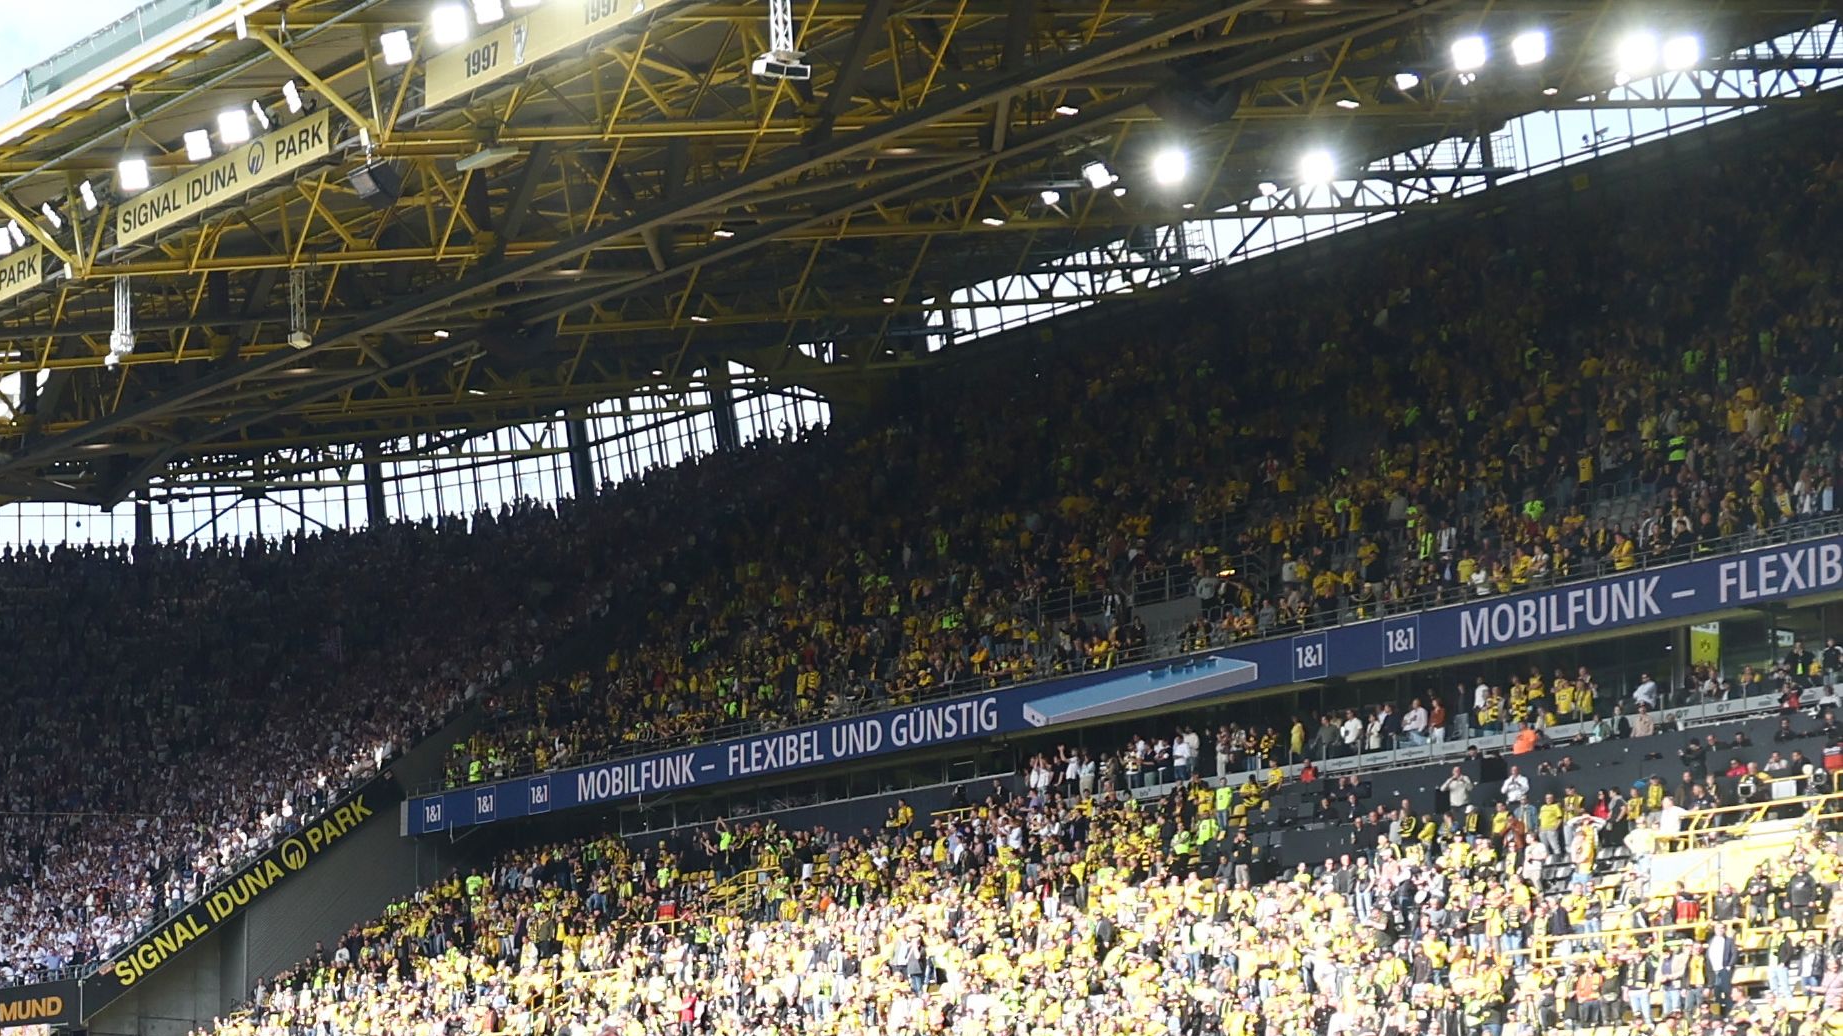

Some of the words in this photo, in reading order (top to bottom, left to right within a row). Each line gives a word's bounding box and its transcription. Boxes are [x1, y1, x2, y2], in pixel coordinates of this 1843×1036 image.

[464, 41, 499, 78] 1997
[122, 190, 181, 234] SIGNAL
[186, 162, 238, 206] IDUNA
[275, 120, 324, 164] PARK
[1460, 575, 1662, 649] MOBILFUNK
[1719, 543, 1843, 603] FLEXIB
[1295, 643, 1324, 669] 1&1
[1386, 627, 1415, 654] 1&1
[577, 752, 696, 802] MOBILFUNK
[728, 730, 824, 776] FLEXIBEL
[832, 719, 883, 758] UND
[891, 697, 998, 747] GÜNSTIG
[476, 794, 494, 814] 1&1
[530, 784, 548, 804] 1&1
[425, 804, 441, 823] 1&1
[114, 913, 208, 986] SIGNAL
[205, 858, 285, 923] IDUNA
[305, 794, 374, 853] PARK
